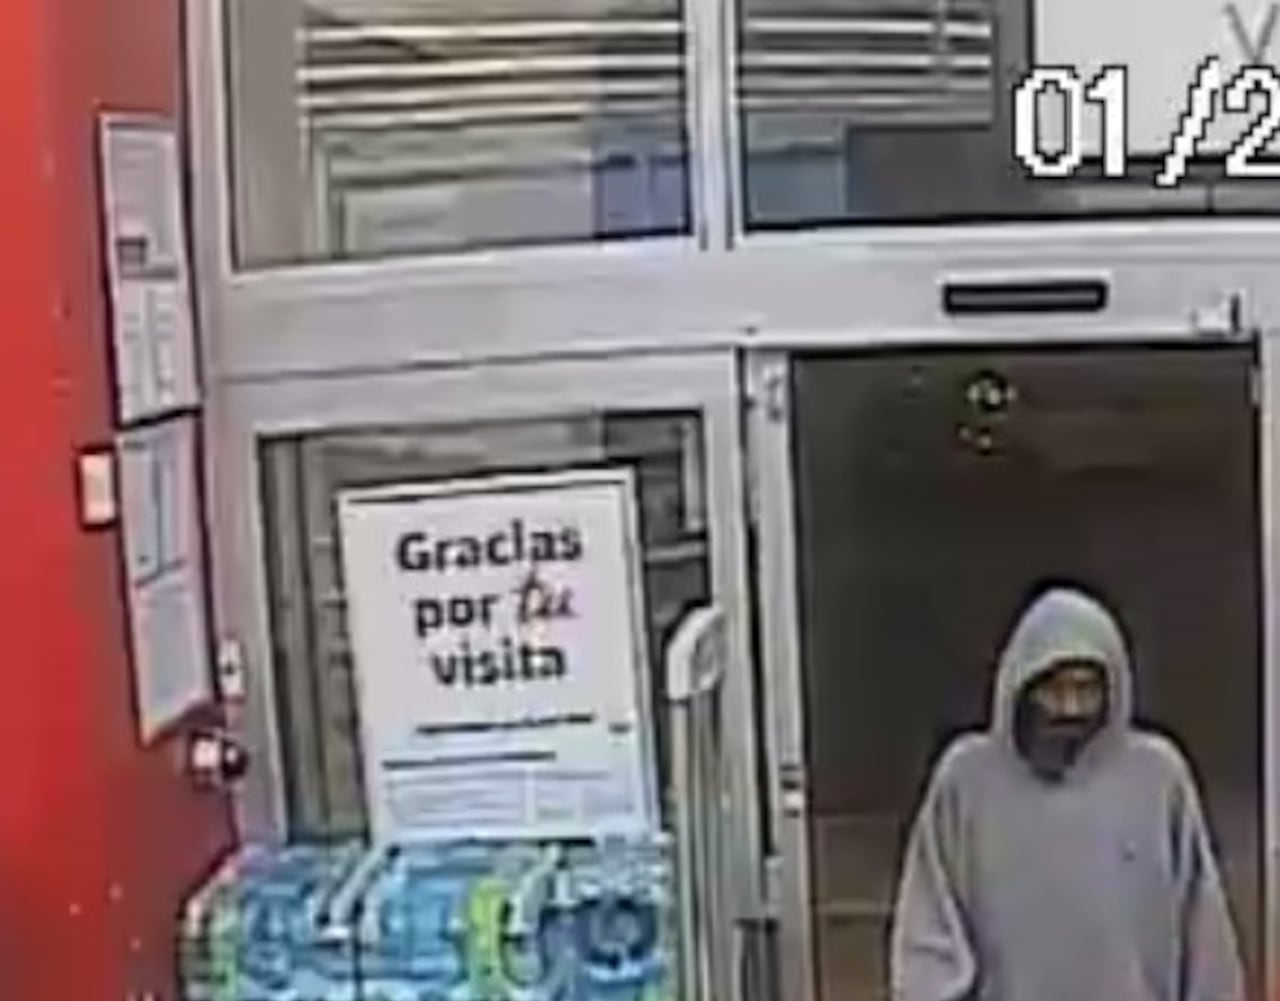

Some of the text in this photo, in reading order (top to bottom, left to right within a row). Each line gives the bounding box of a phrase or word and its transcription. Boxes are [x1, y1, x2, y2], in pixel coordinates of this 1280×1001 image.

[397, 519, 584, 571] Gracias
[415, 594, 500, 638] por
[432, 638, 568, 687] visita
